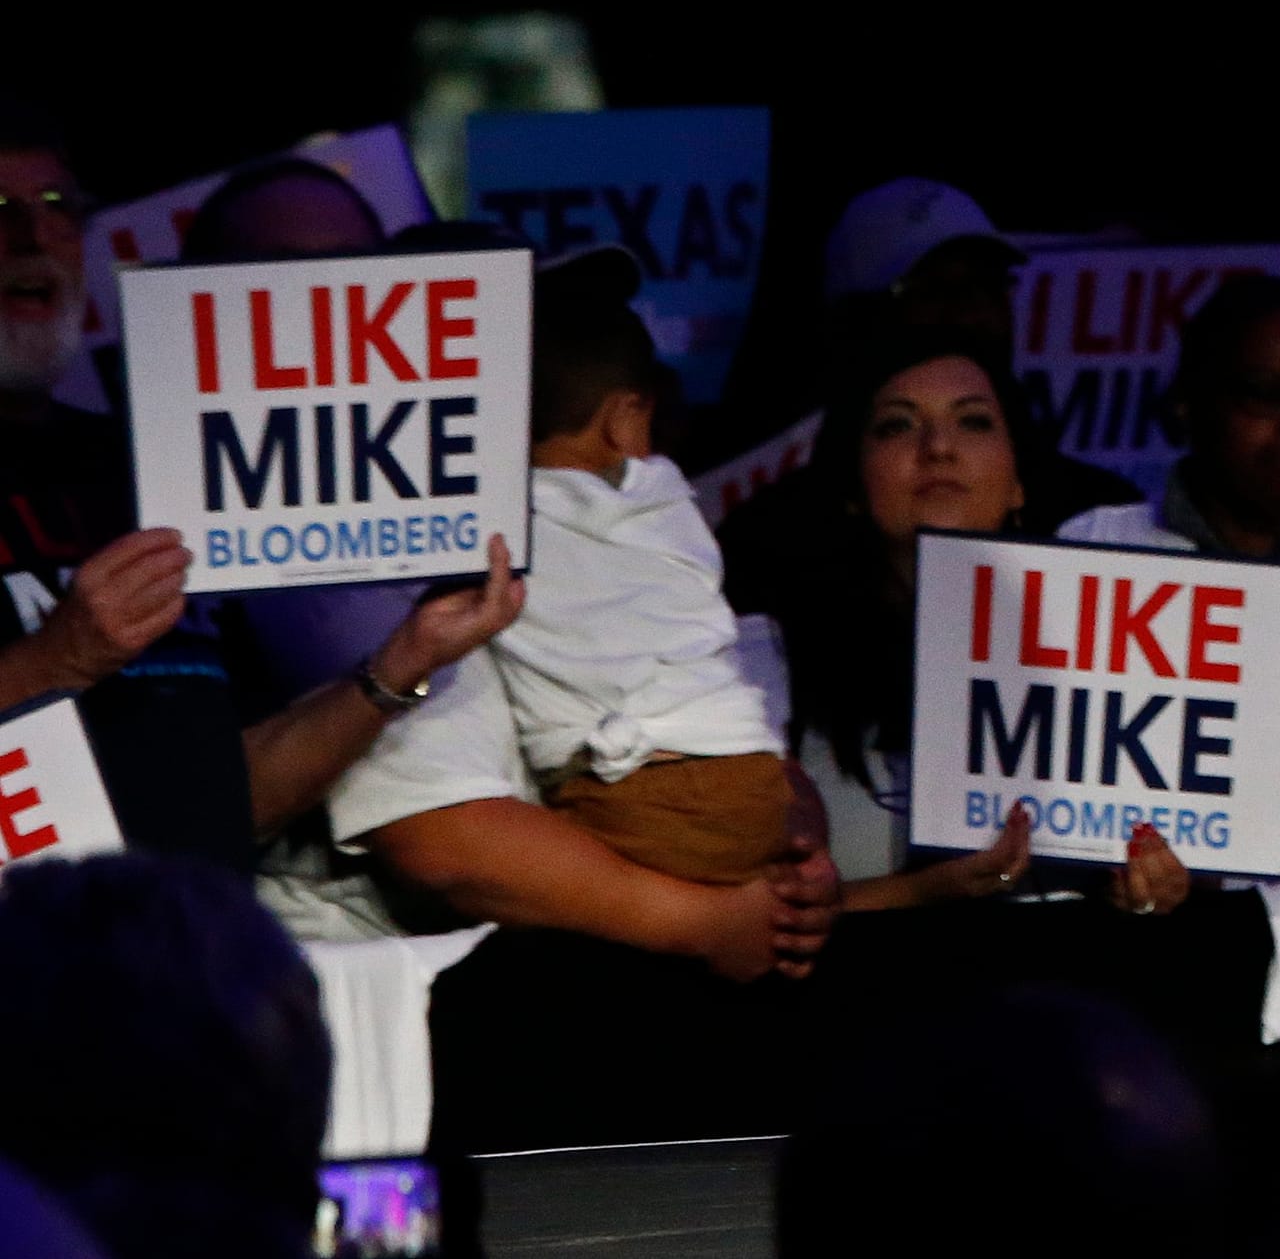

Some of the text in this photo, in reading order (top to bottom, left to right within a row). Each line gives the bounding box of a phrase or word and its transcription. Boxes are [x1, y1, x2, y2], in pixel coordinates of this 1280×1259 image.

[193, 278, 479, 394] I LIKE
[1030, 267, 1264, 353] I LIK
[200, 396, 478, 512] MIKE
[206, 512, 480, 569] BLOOMBERG
[971, 565, 1245, 683] I LIKE
[967, 678, 1237, 795] MIKE
